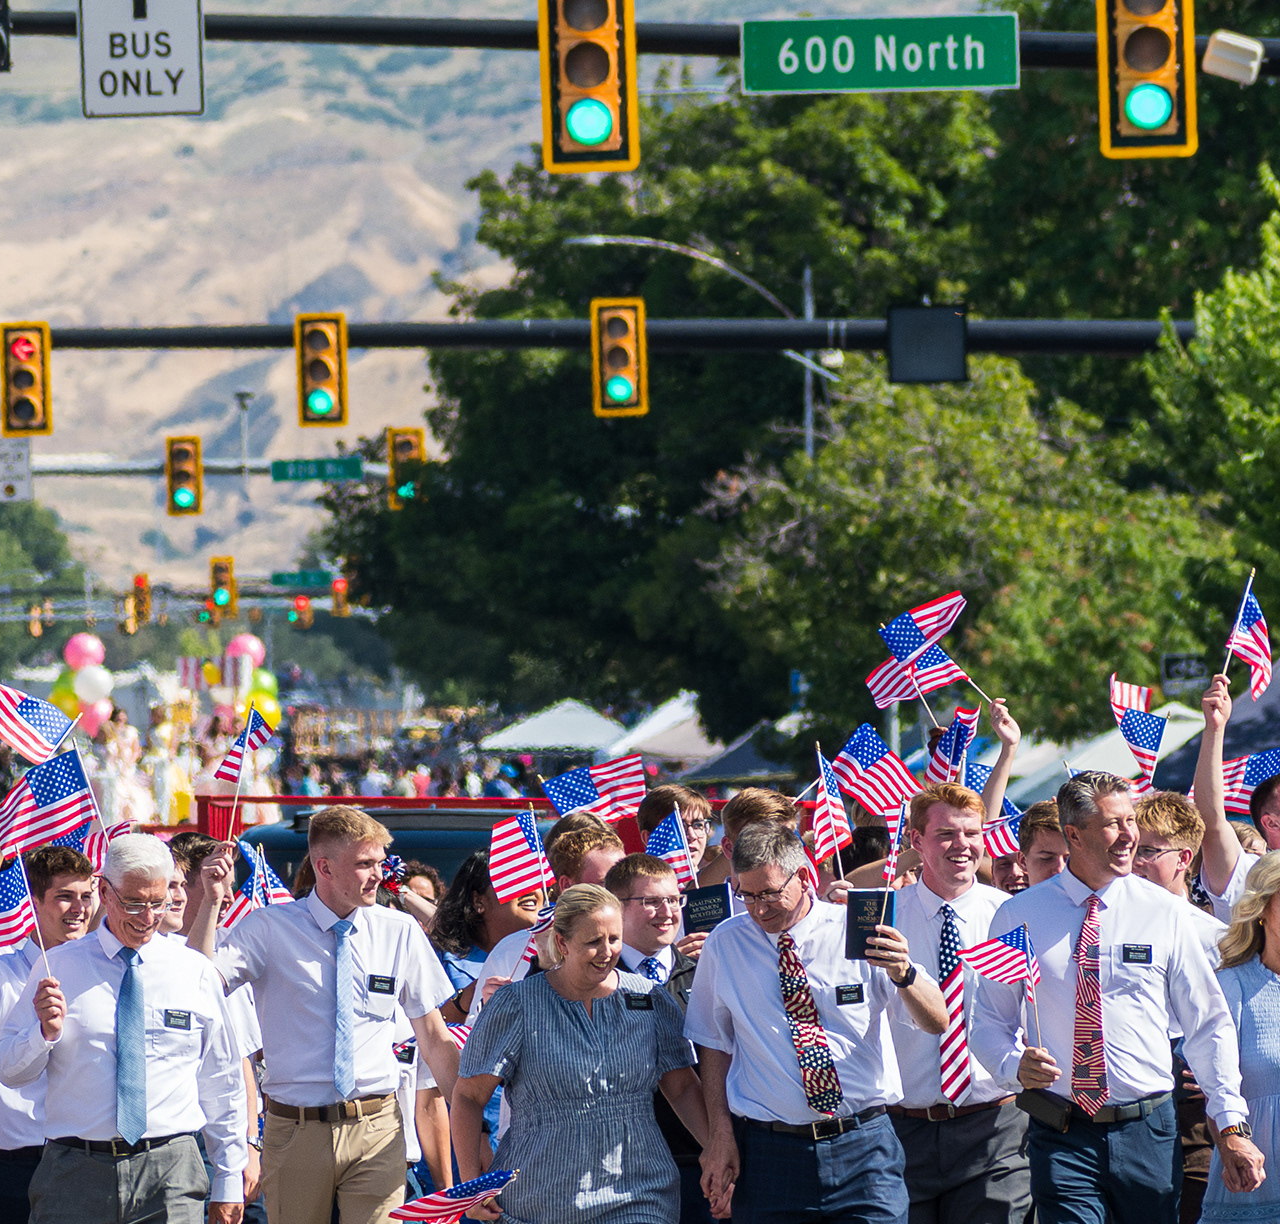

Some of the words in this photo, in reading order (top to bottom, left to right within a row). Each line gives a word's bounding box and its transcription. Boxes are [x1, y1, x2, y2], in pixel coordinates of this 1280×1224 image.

[109, 31, 172, 59] BUS
[778, 35, 855, 75] 600
[875, 34, 985, 72] North
[99, 68, 184, 97] ONLY
